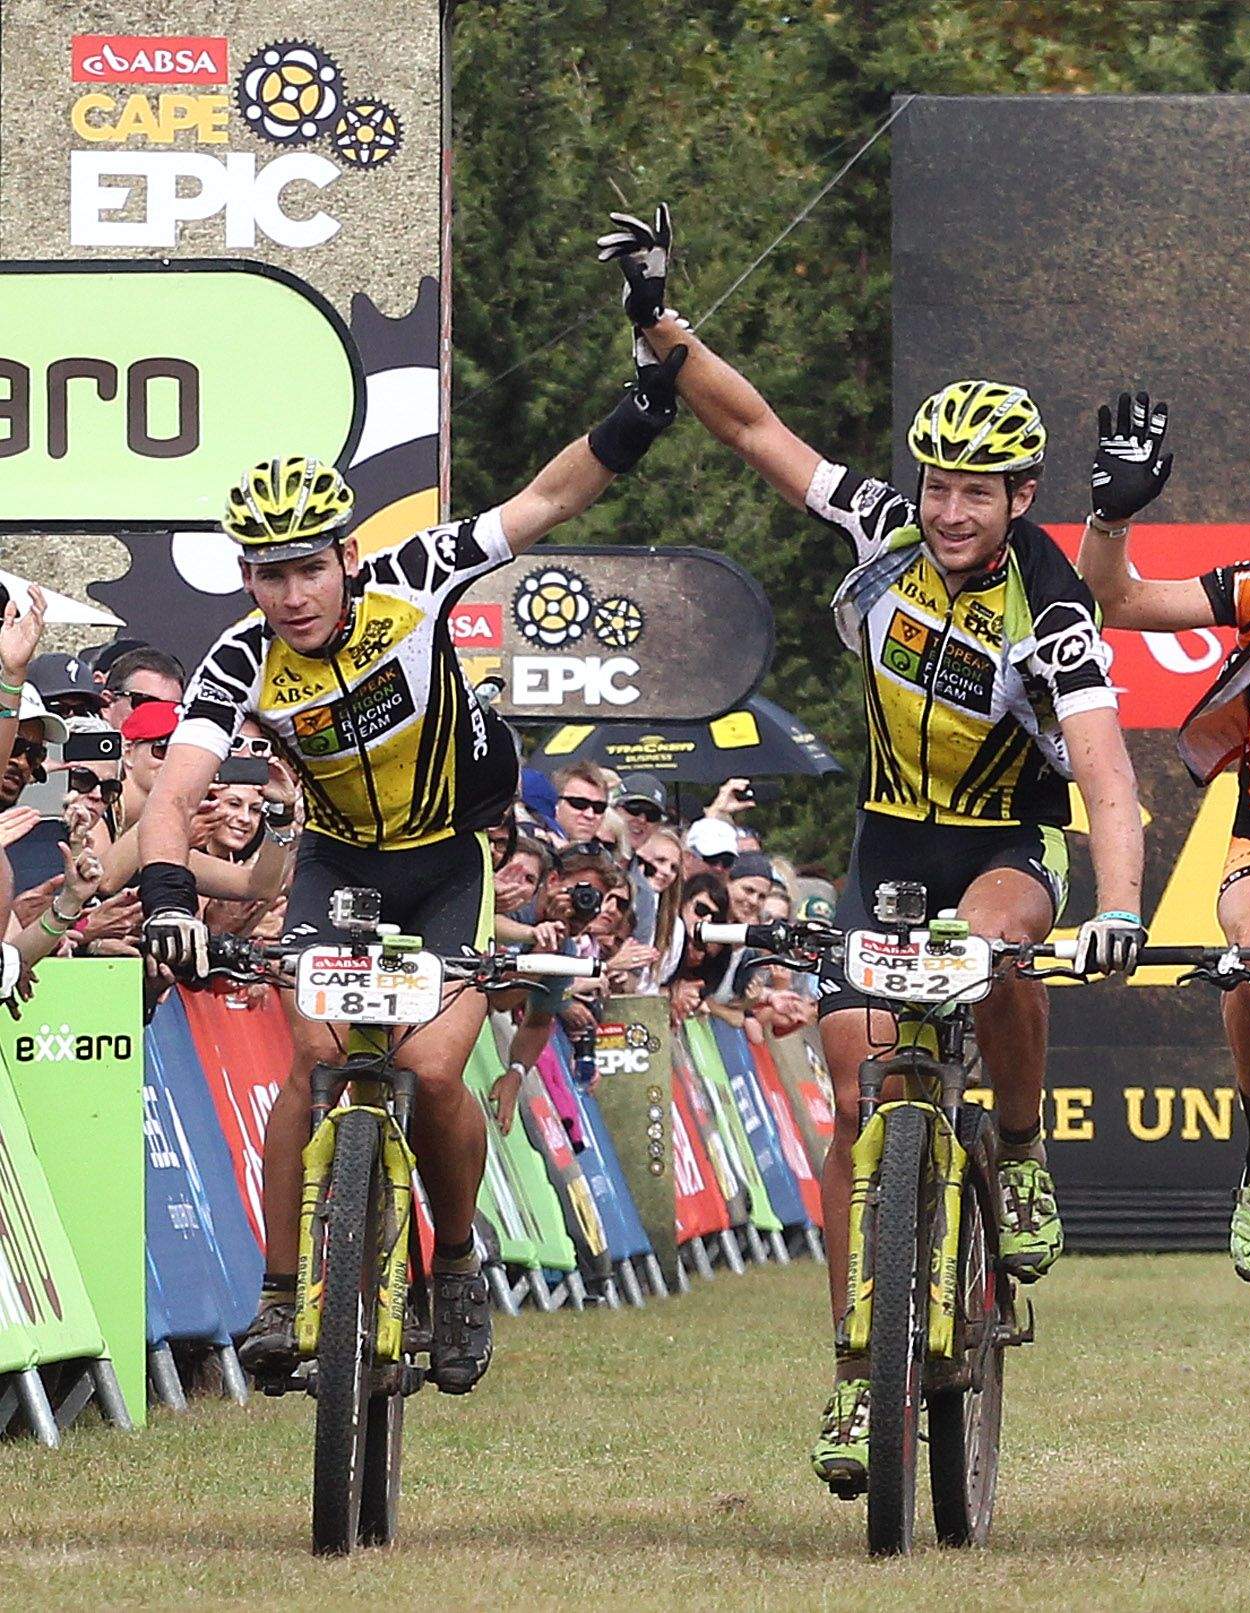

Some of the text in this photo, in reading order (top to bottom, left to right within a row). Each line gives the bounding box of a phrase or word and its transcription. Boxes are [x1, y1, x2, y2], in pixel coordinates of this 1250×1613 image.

[129, 48, 218, 74] ABSA
[71, 93, 230, 144] CAPE
[70, 150, 343, 249] EPIC
[896, 575, 939, 614] ABSA
[447, 614, 494, 640] SA
[273, 683, 324, 705] ABSA
[512, 656, 641, 705] EPIC
[923, 673, 968, 701] TEAM
[341, 693, 403, 733] RACING
[344, 713, 392, 743] TEAM
[470, 707, 489, 762] EPIC
[858, 951, 980, 972] CAPE EPIC
[309, 972, 430, 990] CAPE EPIC
[884, 973, 951, 995] 8-2
[340, 991, 398, 1016] 8-1
[16, 1023, 132, 1062] exxaro
[595, 1049, 650, 1074] EPIC
